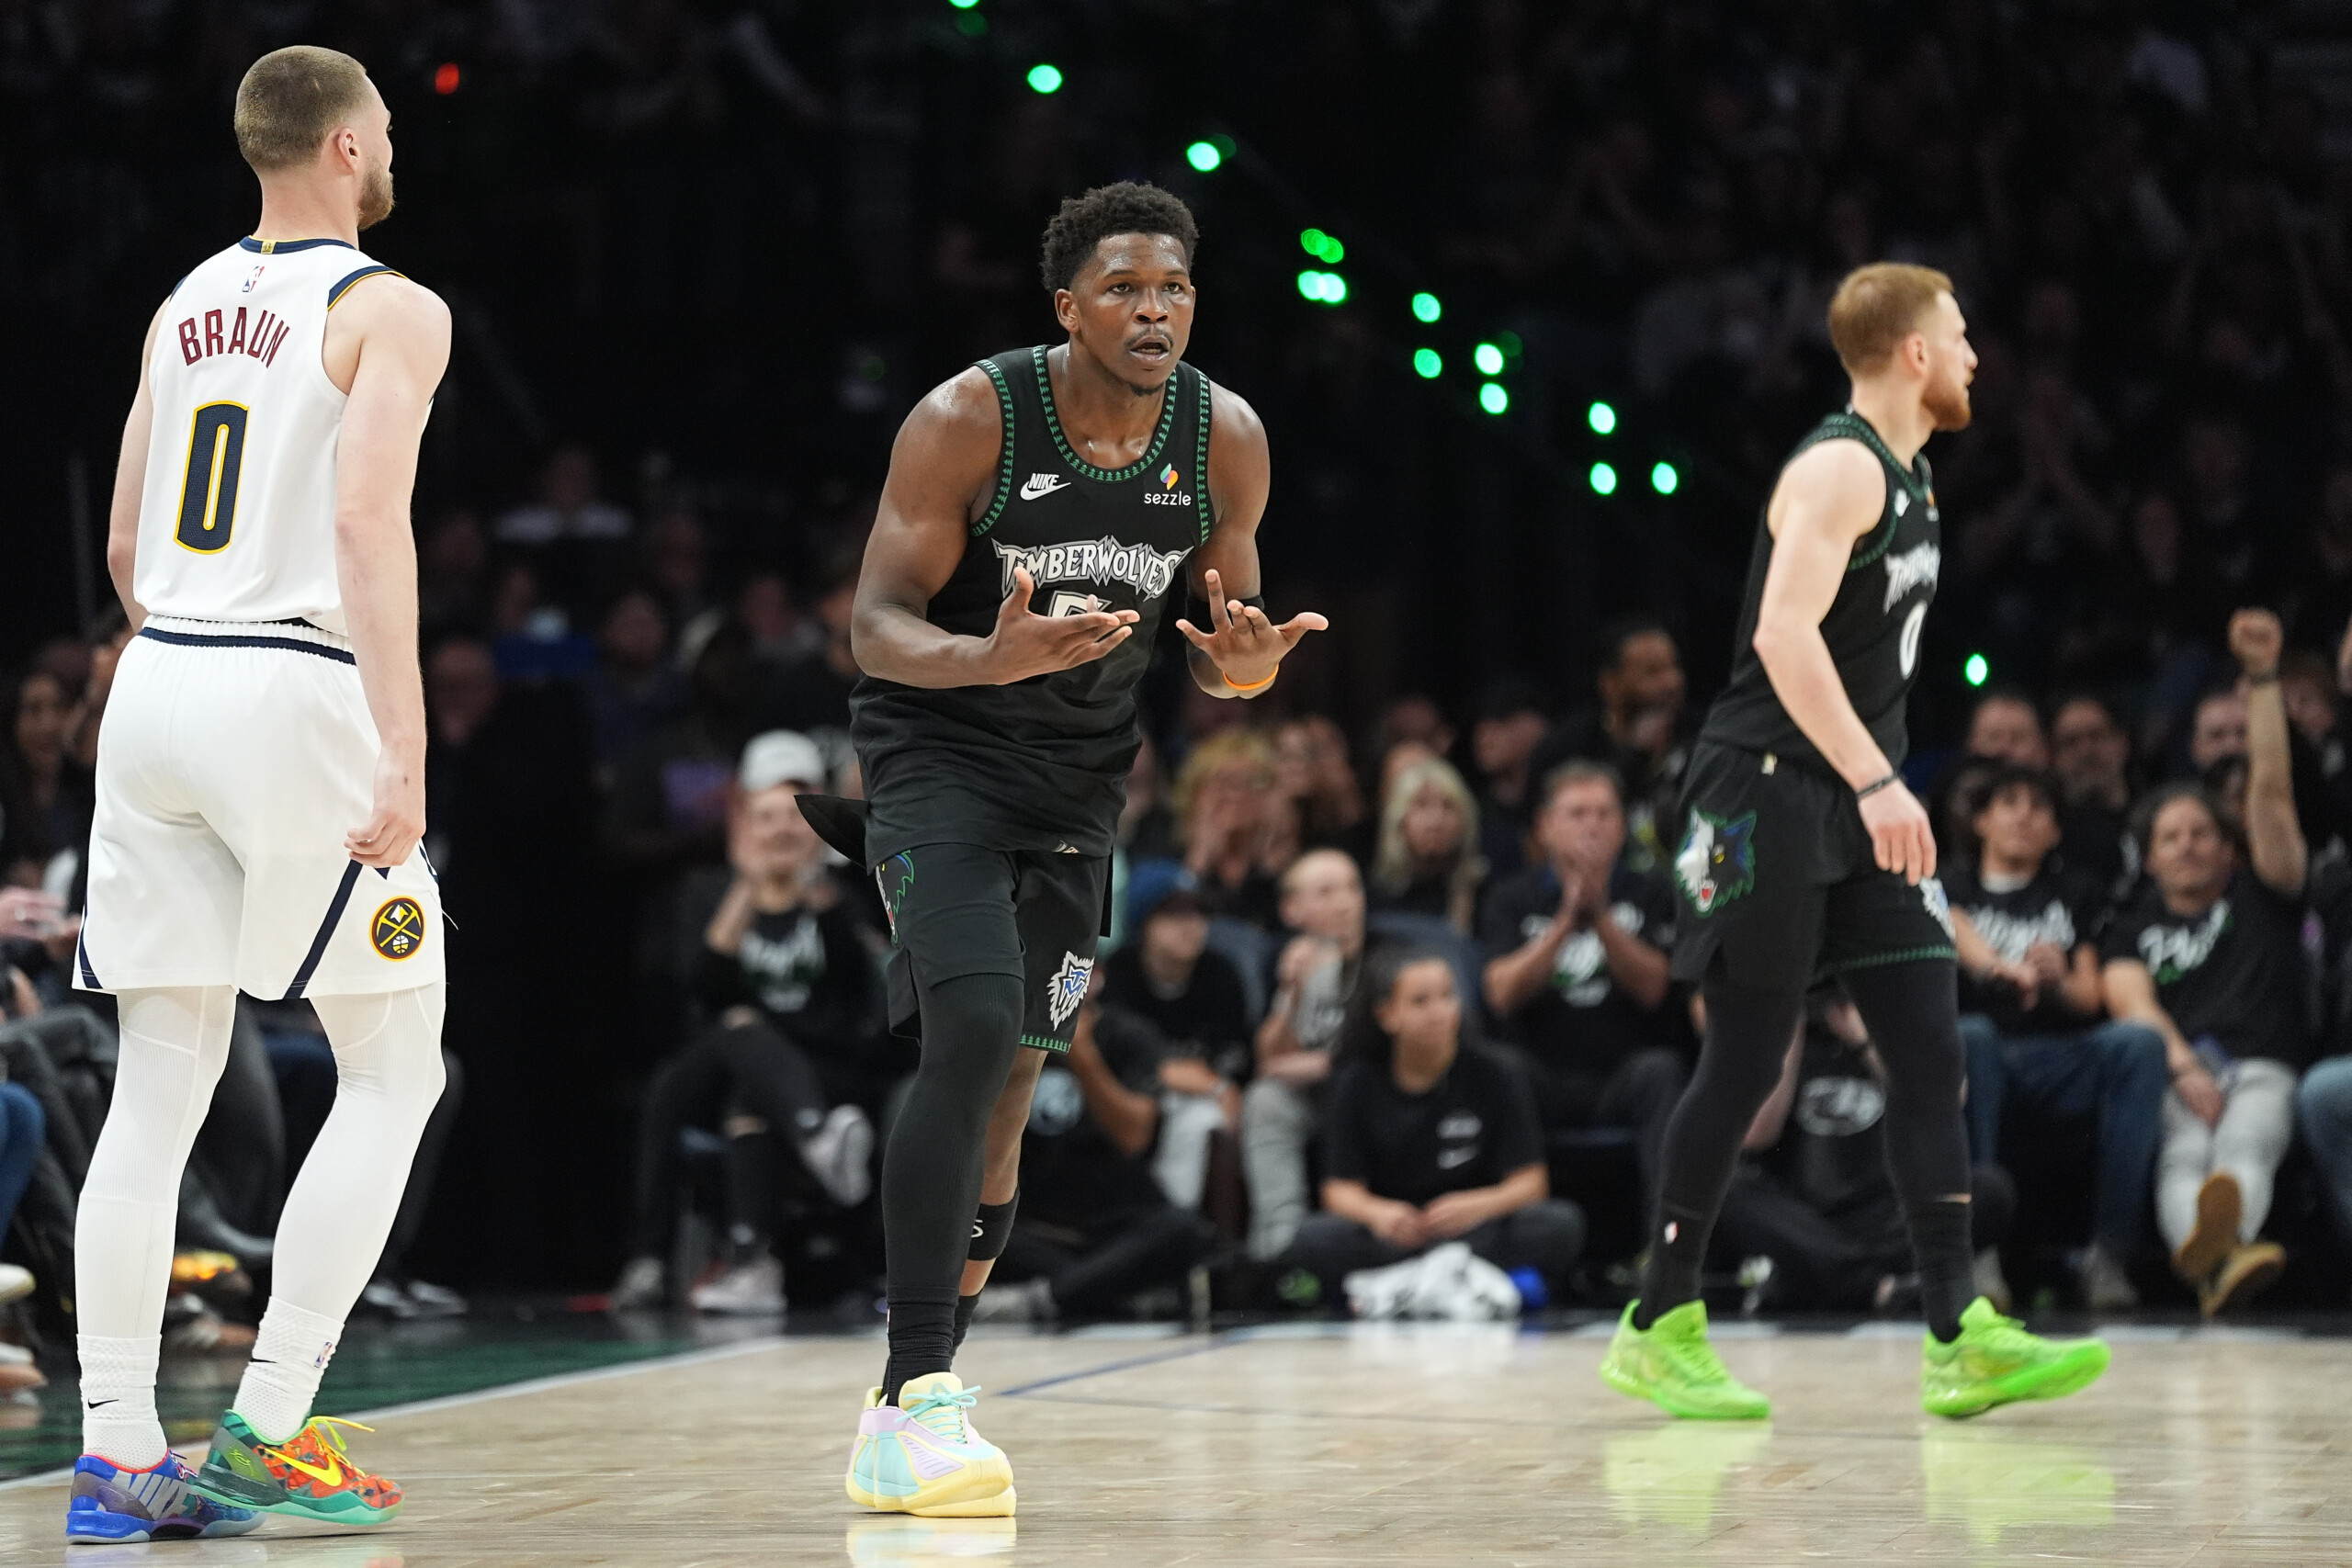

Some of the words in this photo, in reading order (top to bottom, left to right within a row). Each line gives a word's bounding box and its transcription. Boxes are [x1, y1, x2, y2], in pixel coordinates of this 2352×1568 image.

[178, 306, 290, 368] BRAUN
[174, 400, 250, 555] 0
[1028, 472, 1059, 490] NIKE
[1144, 490, 1192, 506] sezzle
[1899, 600, 1928, 680] 0
